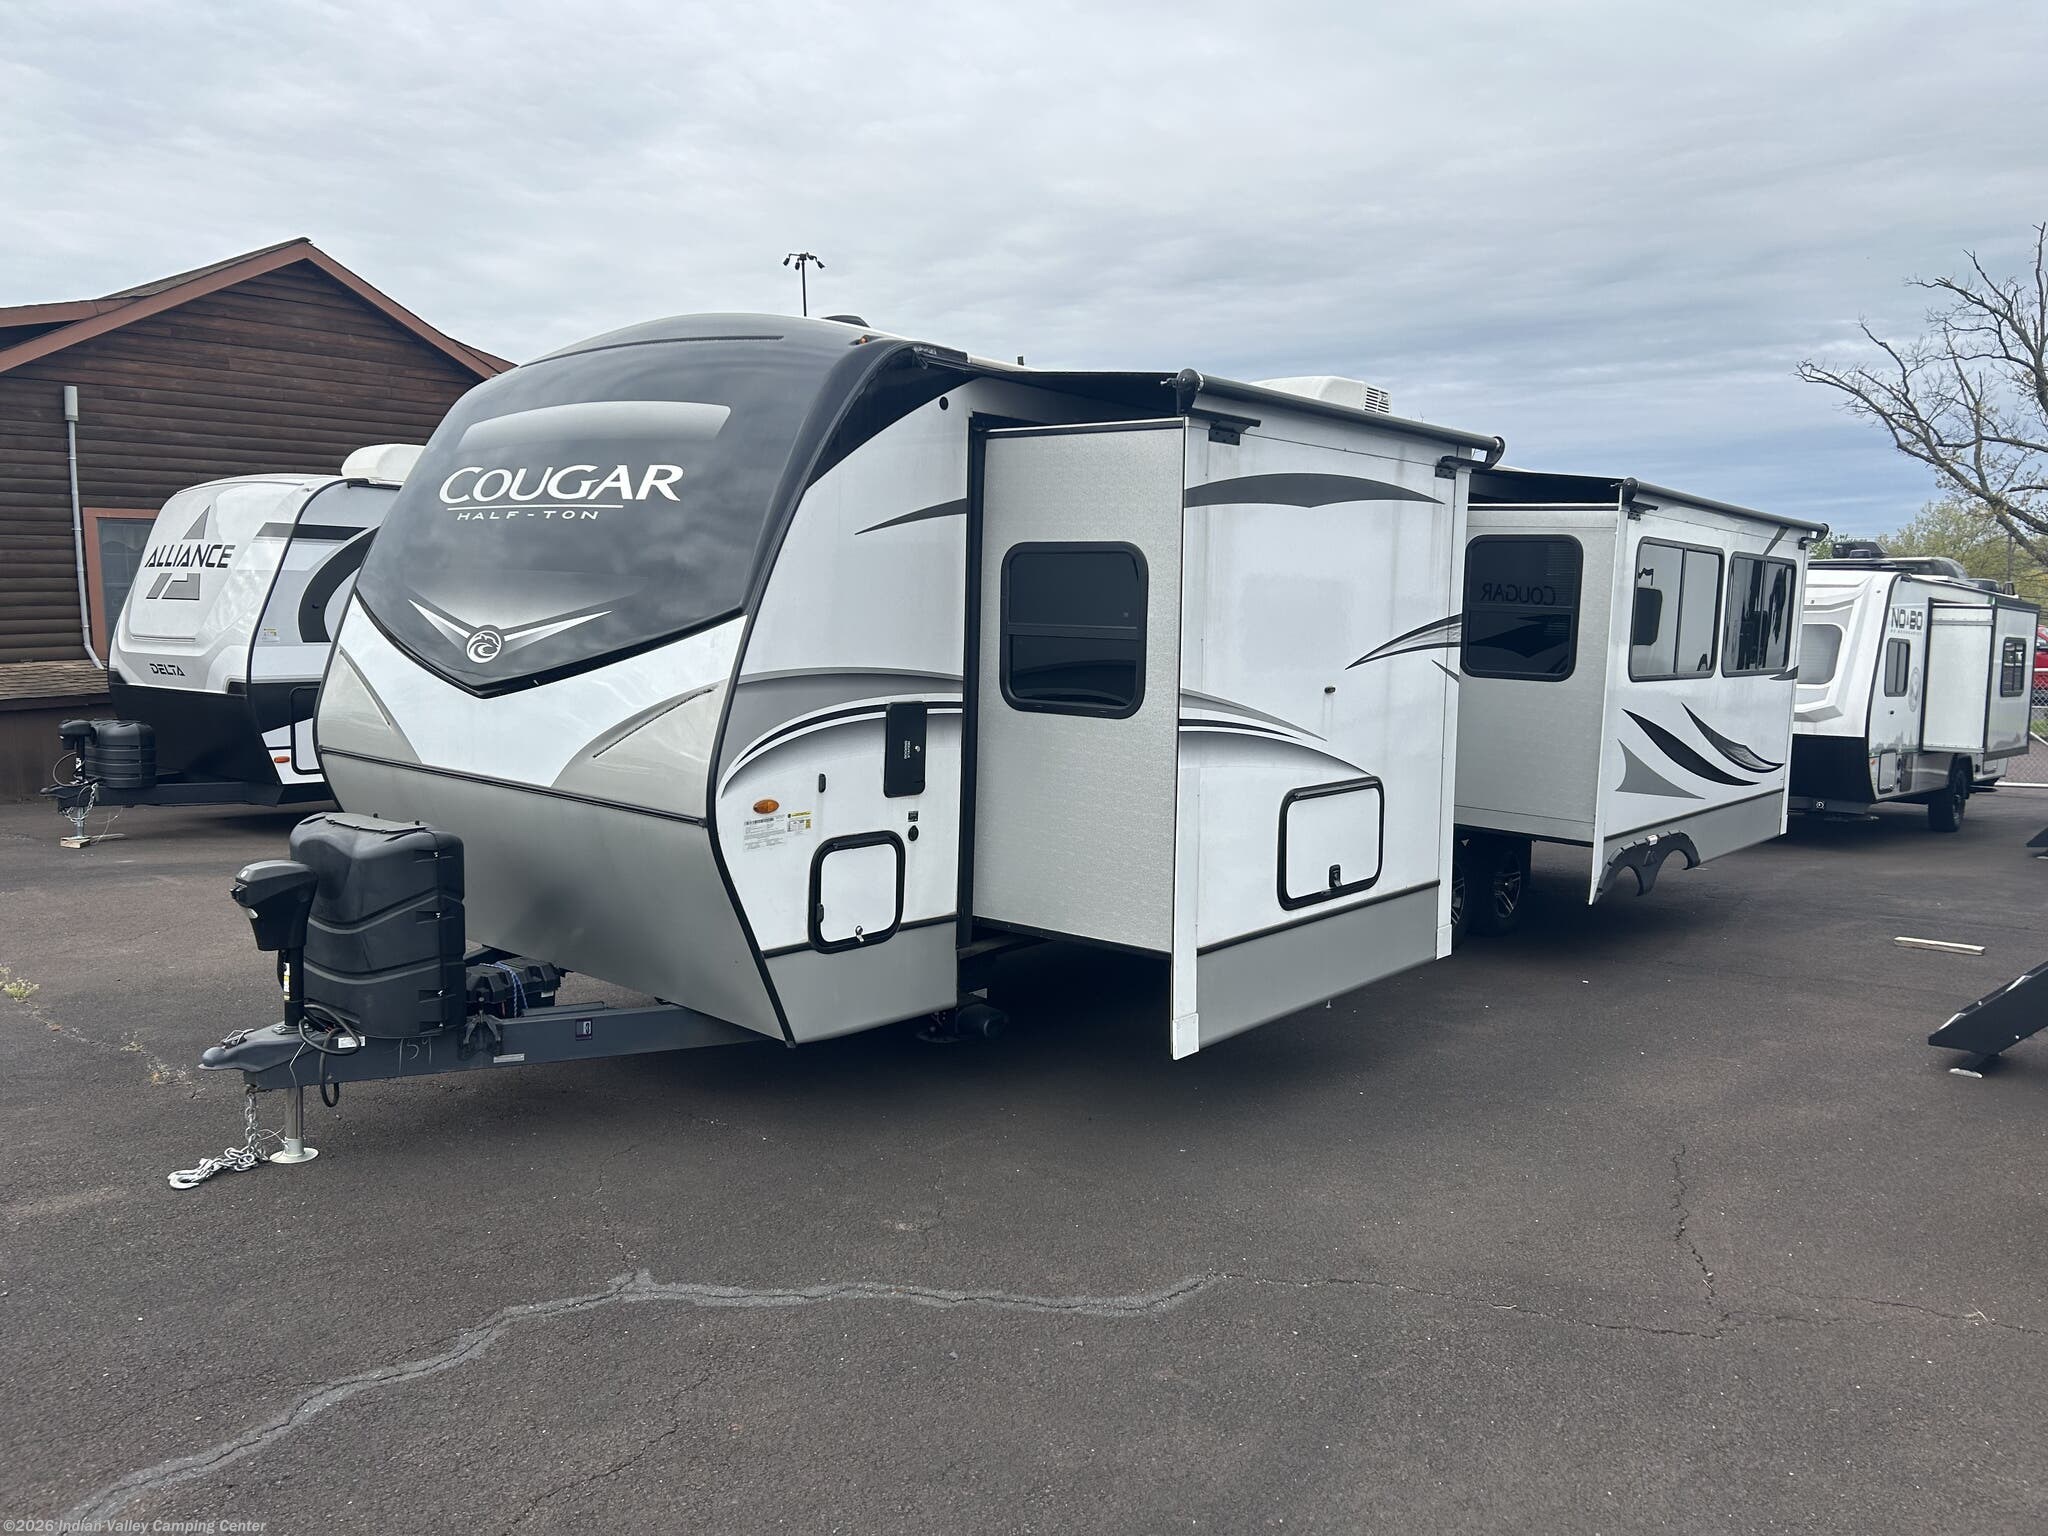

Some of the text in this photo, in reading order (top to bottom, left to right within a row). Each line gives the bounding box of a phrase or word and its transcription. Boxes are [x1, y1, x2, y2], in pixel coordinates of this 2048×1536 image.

[439, 464, 684, 504] COUGAR
[144, 544, 236, 568] ALLIANCE
[149, 663, 186, 676] DELTA
